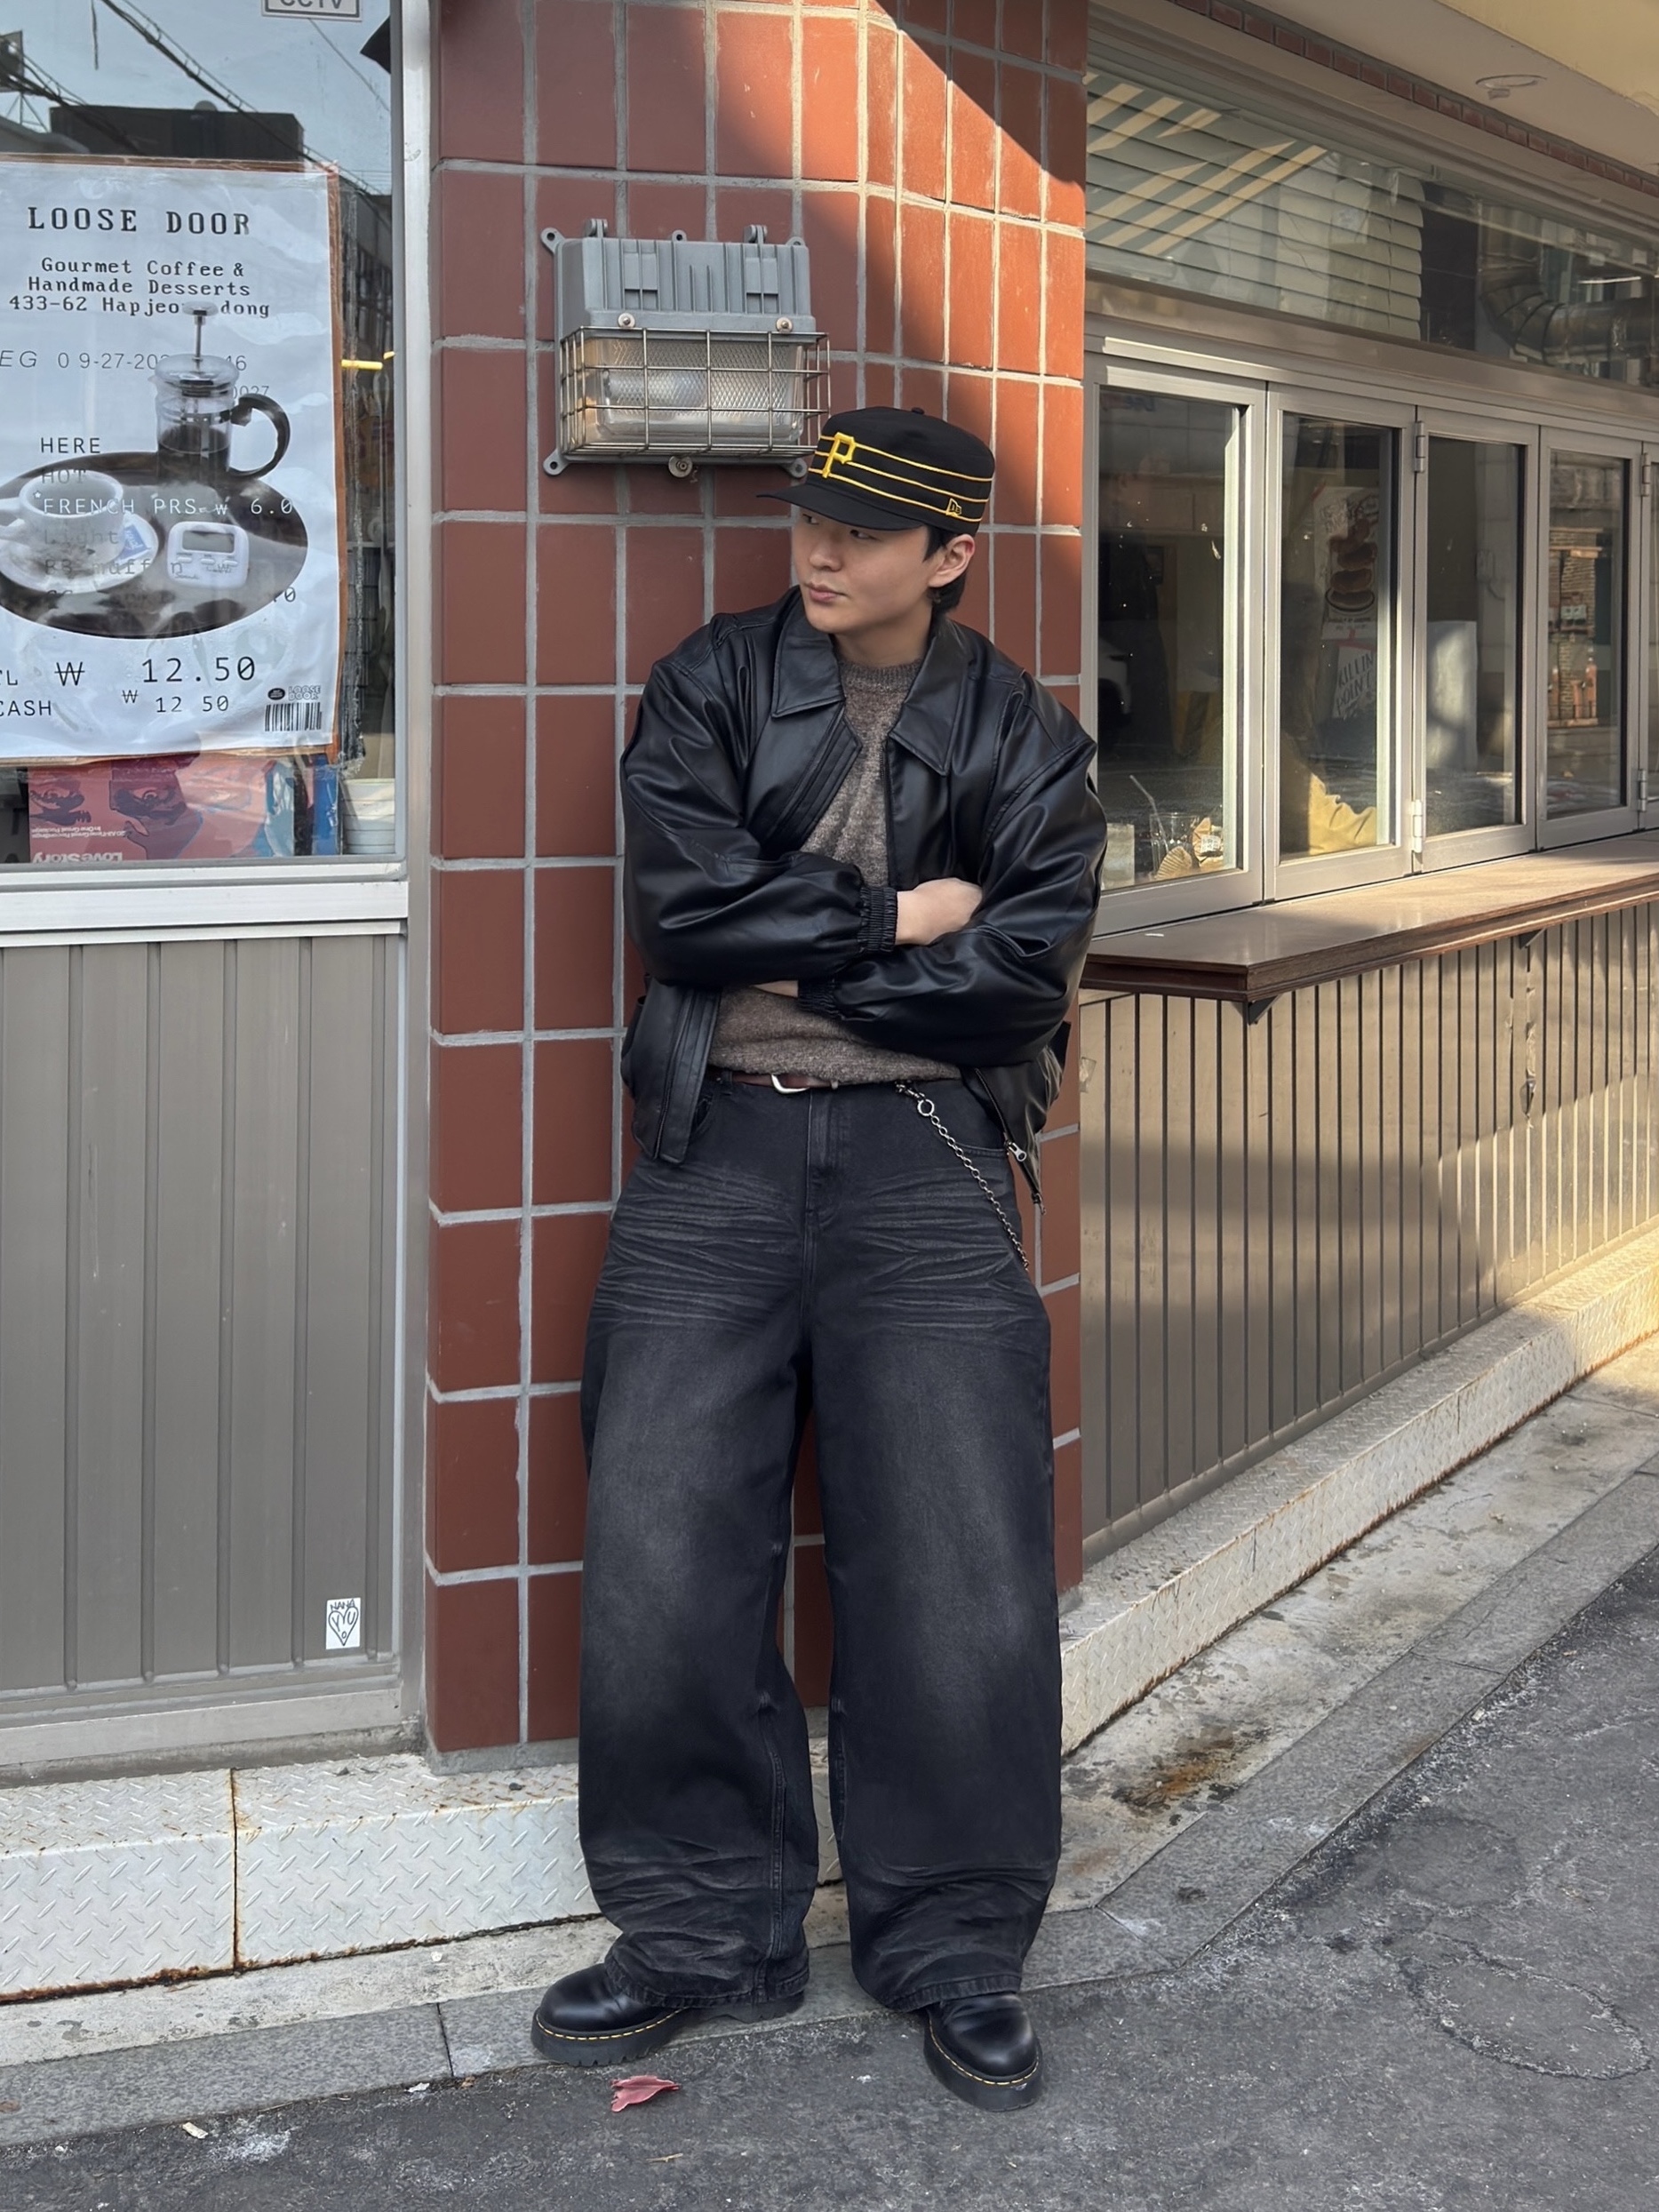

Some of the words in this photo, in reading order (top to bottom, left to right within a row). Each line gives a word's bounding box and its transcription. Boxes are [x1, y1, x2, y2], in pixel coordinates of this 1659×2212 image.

[28, 206, 137, 232] LOOSE
[166, 211, 250, 236] DOOR
[41, 257, 132, 274] Gourmet
[147, 260, 224, 276] Coffee
[233, 262, 244, 277] &
[28, 276, 133, 293] Handmade
[148, 279, 251, 296] Desserts
[9, 295, 87, 311] 433-62
[41, 436, 101, 454] HERE
[822, 432, 857, 478] P
[43, 468, 87, 484] HOT
[44, 498, 134, 515] FRENCH
[0, 669, 19, 686] L
[142, 656, 256, 683] 12.50
